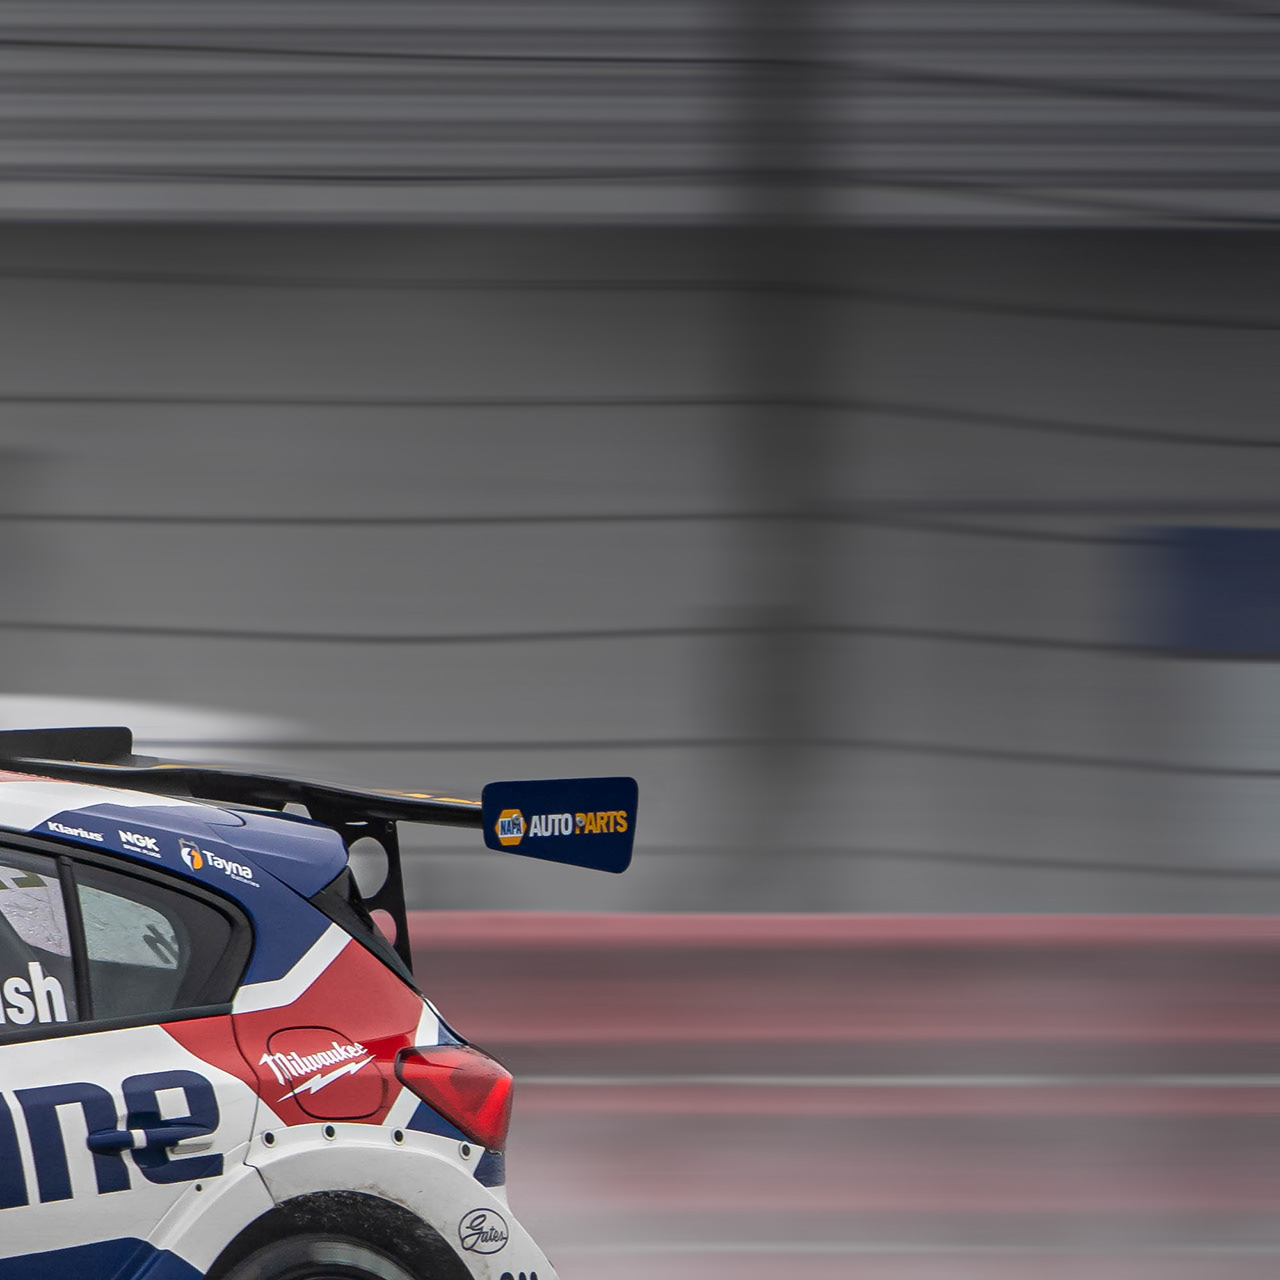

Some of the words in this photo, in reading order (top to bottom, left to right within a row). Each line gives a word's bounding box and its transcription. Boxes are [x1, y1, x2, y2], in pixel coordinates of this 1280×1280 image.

[47, 821, 104, 842] Klarius
[529, 813, 573, 837] AUTO
[575, 810, 628, 834] PARTS
[118, 830, 160, 851] NGK
[202, 850, 254, 880] Tayna
[259, 1041, 368, 1086] Milwaukee
[462, 1213, 508, 1249] Gates
